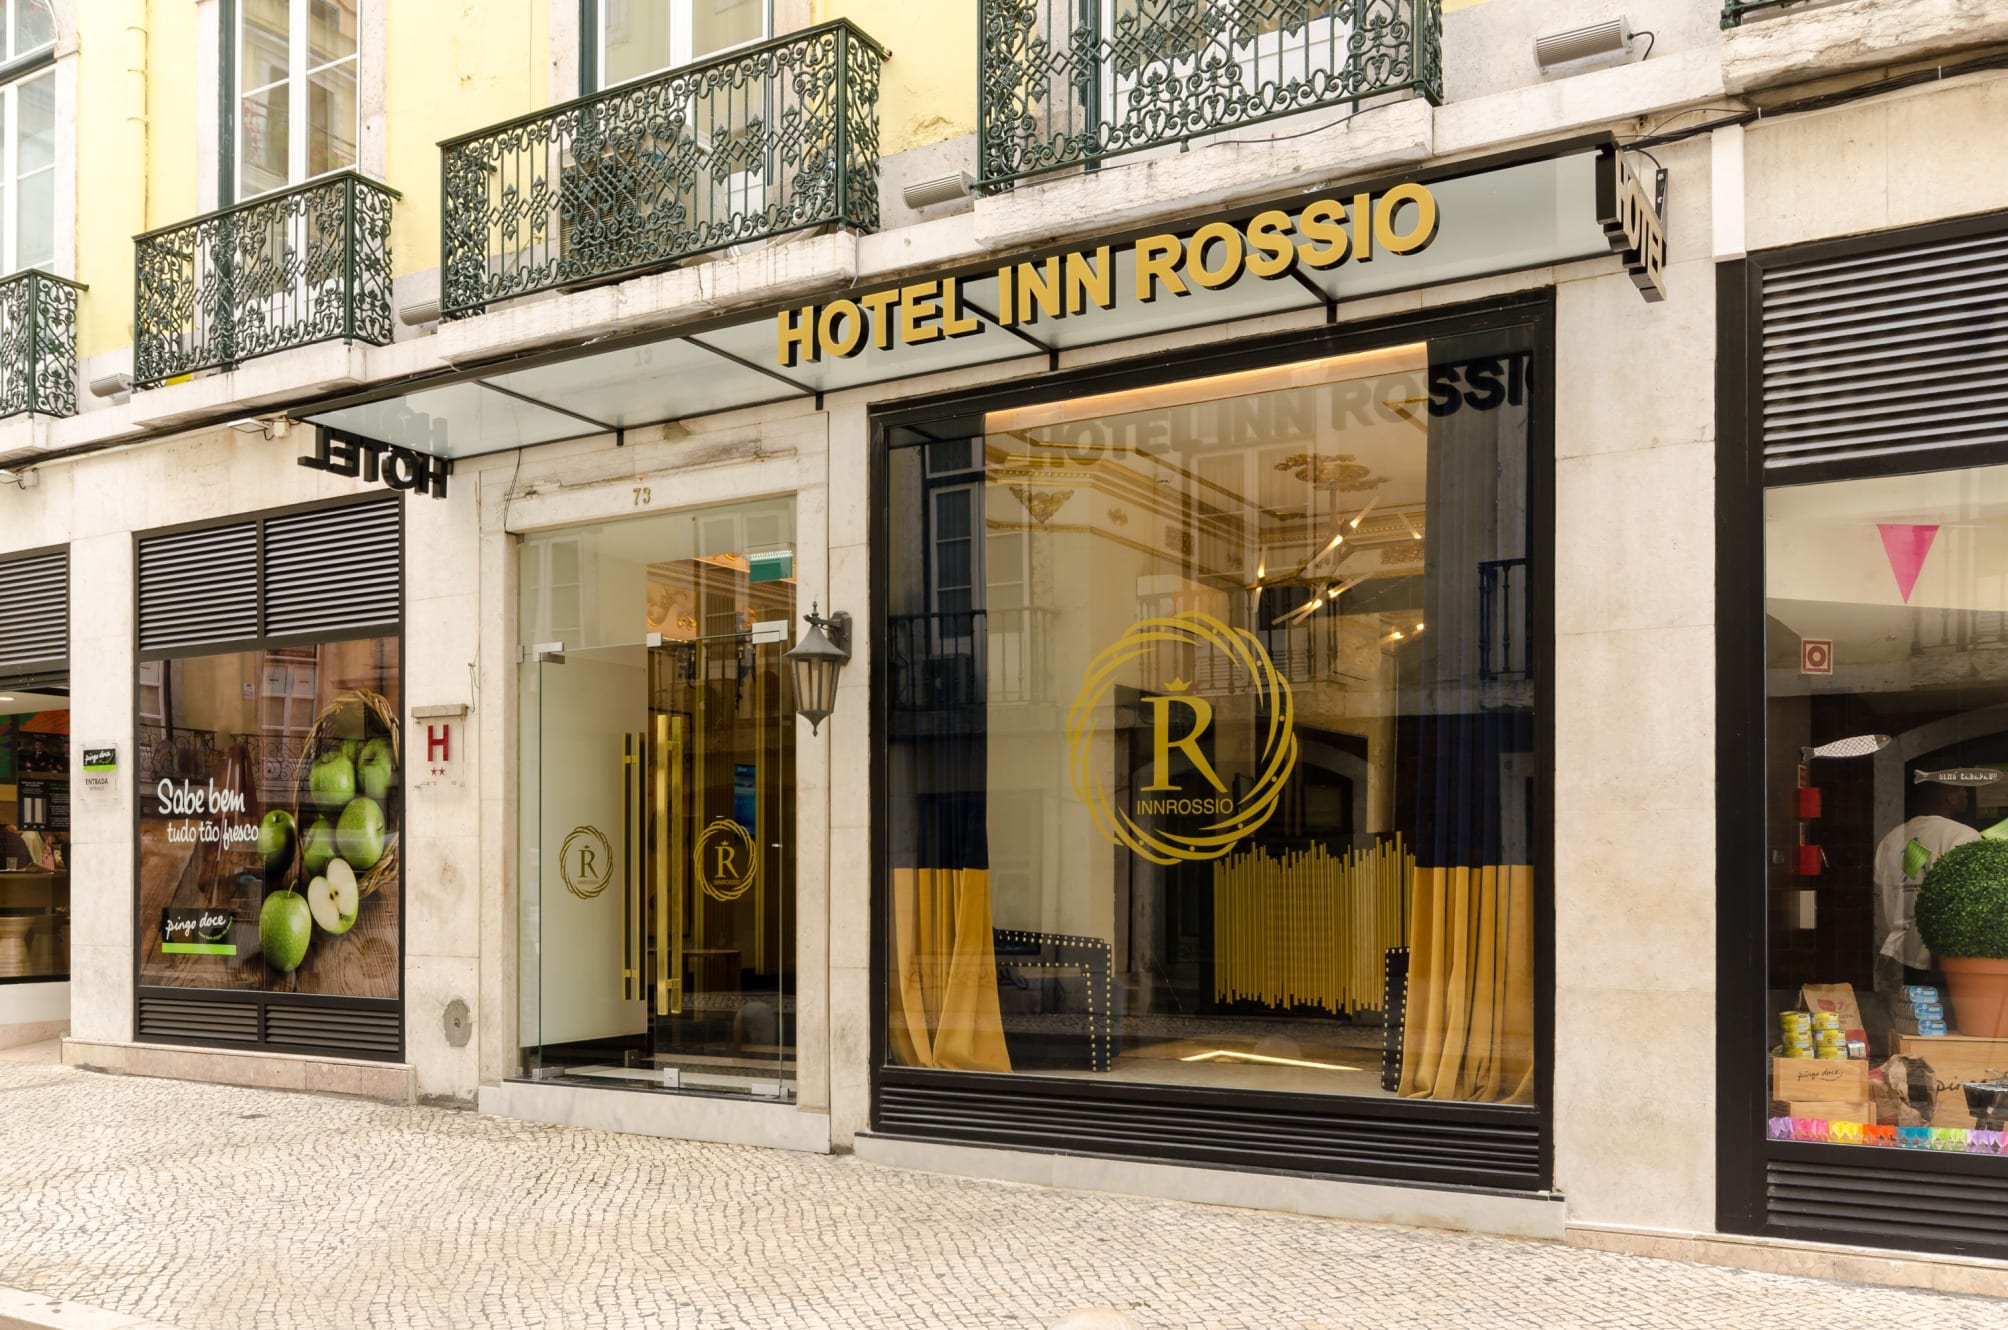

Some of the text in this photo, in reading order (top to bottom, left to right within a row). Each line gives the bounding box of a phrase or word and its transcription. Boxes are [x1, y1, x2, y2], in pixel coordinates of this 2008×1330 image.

[1614, 150, 1668, 302] HOTEL
[777, 183, 1439, 367] HOTEL INN ROSSIO
[632, 487, 651, 505] 73
[427, 724, 449, 762] H
[1140, 695, 1228, 794] R
[85, 777, 109, 786] ENTRADA
[157, 777, 246, 815] Sabe bem
[1136, 798, 1234, 816] INNROSSIO
[167, 818, 259, 851] tudo tão fresco
[165, 916, 197, 941] pingo
[199, 911, 227, 928] doce
